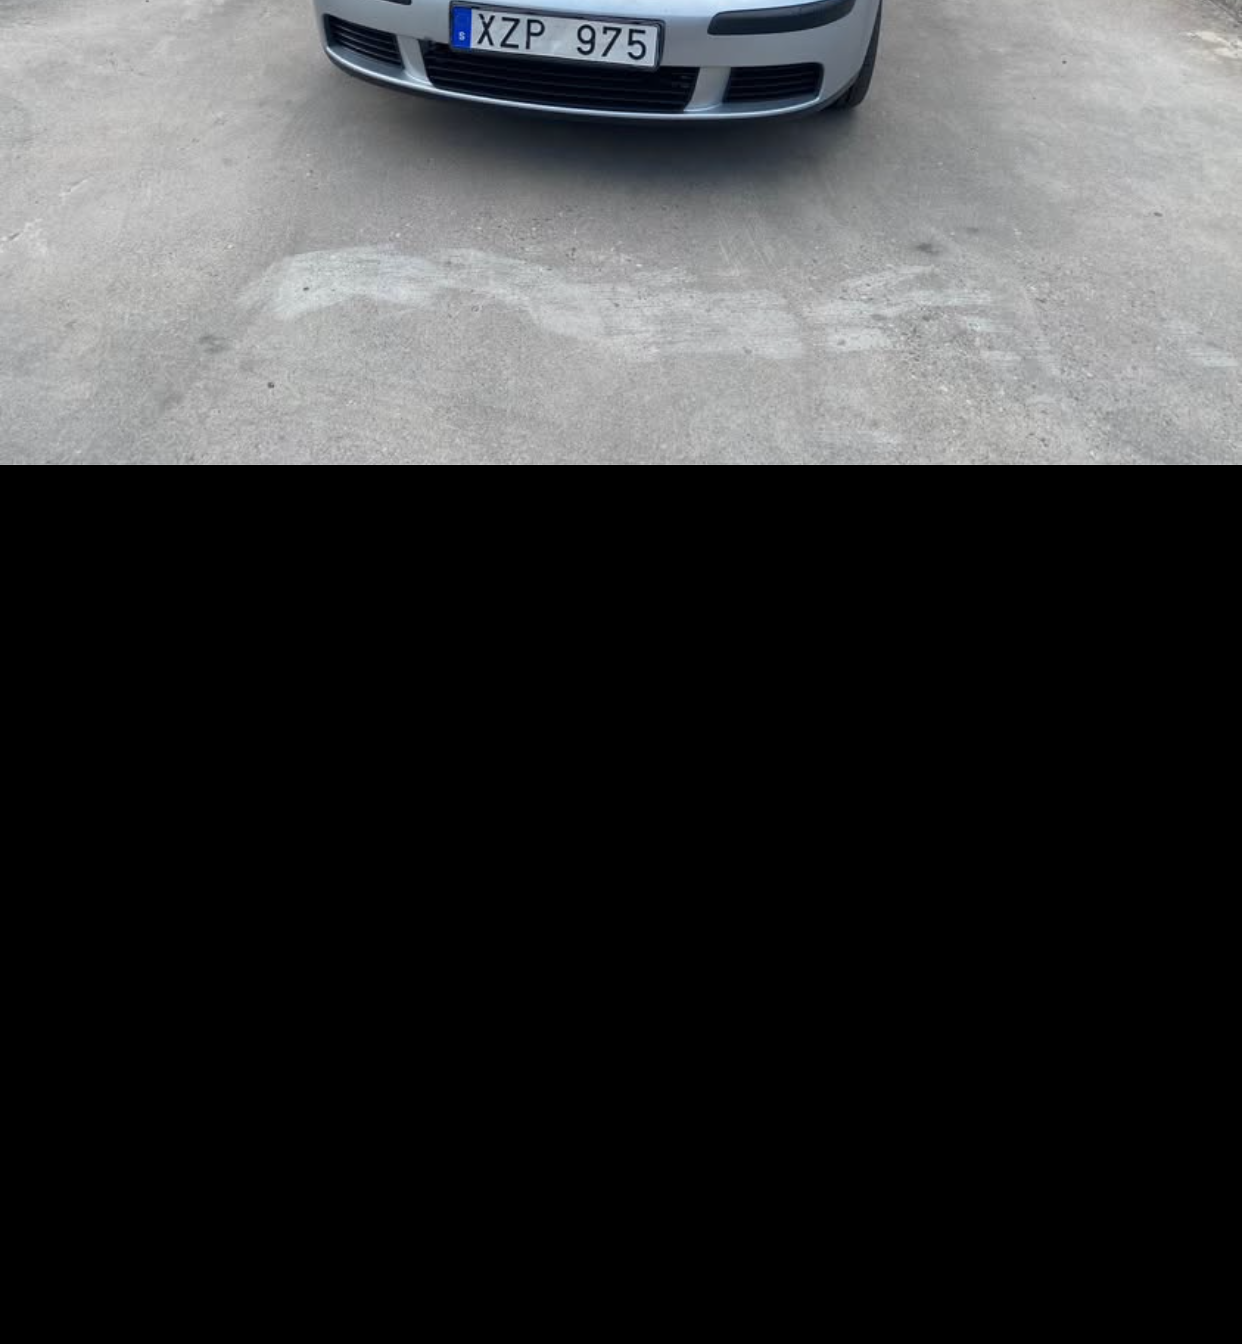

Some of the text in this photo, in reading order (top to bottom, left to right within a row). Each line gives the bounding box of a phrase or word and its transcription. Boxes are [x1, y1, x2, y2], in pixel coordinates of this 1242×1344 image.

[457, 30, 467, 42] S
[476, 13, 647, 61] XZP 975
